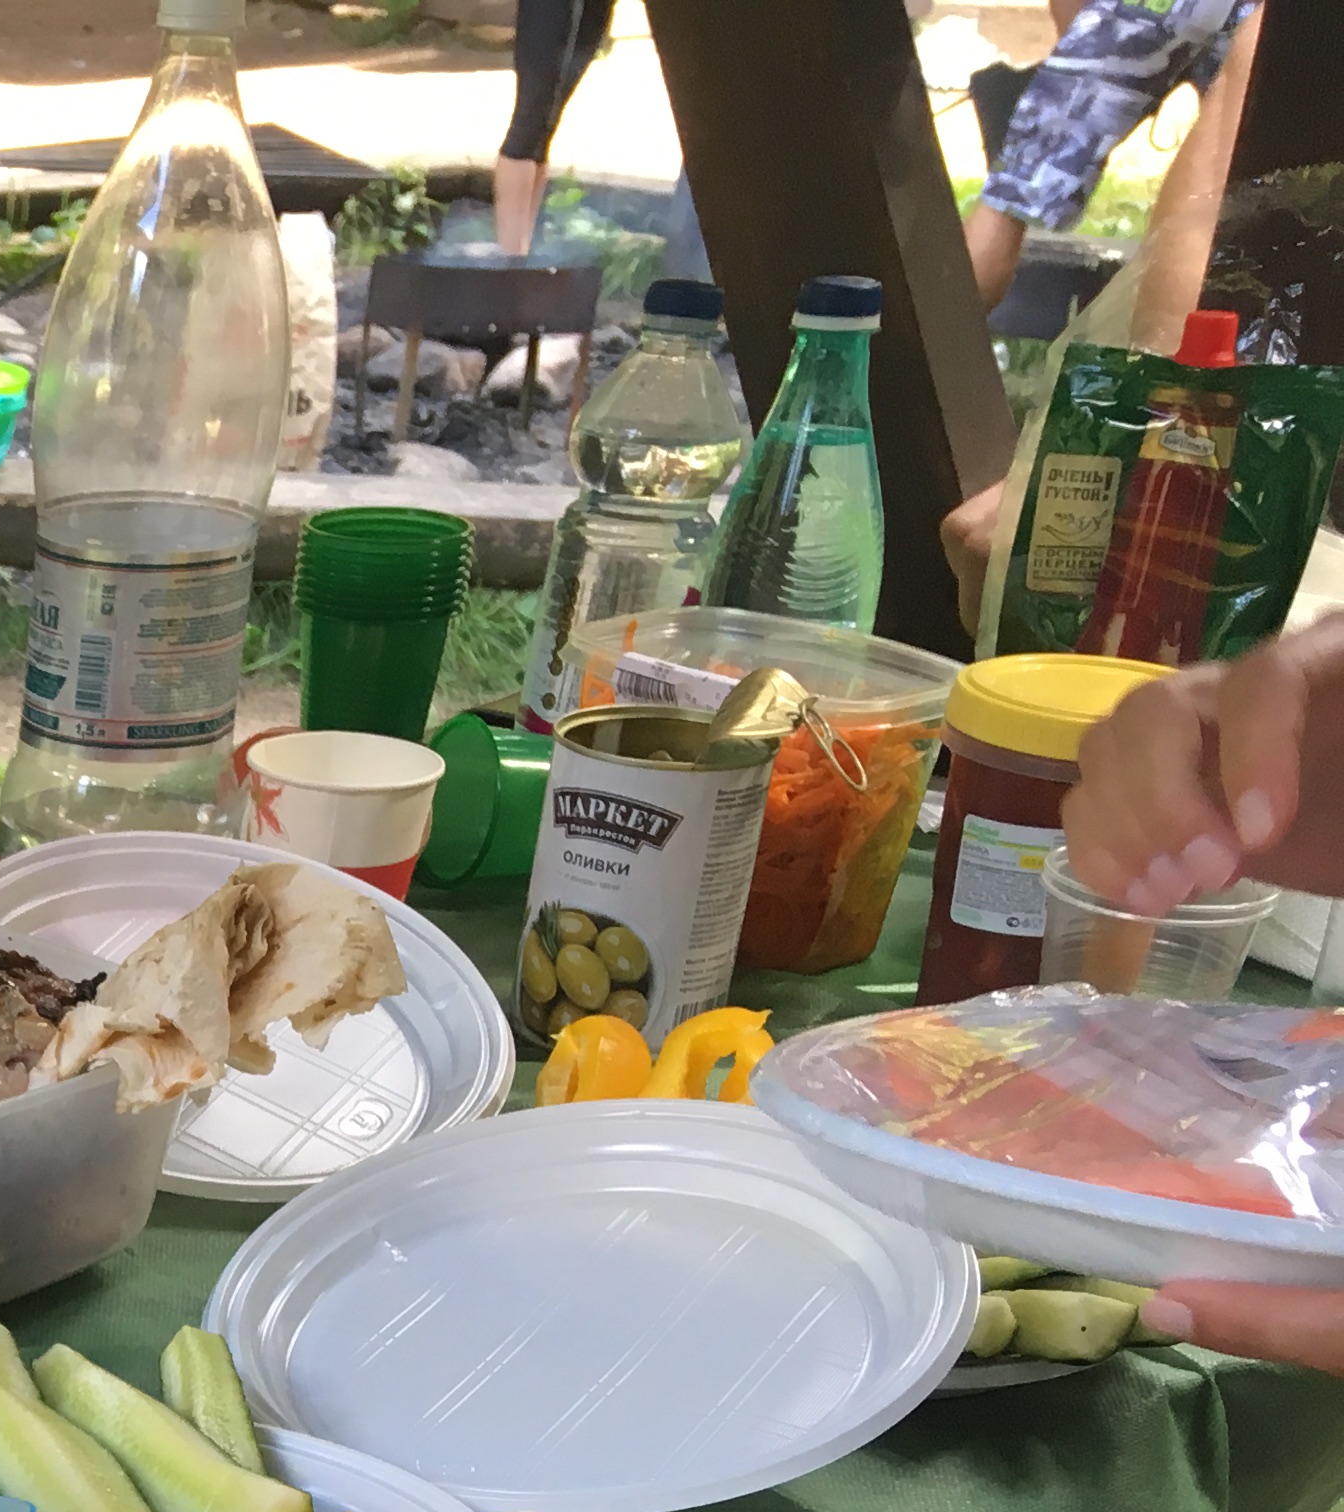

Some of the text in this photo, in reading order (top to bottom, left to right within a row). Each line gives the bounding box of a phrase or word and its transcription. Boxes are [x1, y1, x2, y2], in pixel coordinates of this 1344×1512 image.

[1047, 468, 1104, 484] ОЧЕНЬ
[557, 794, 669, 837] МАРКЕТ
[563, 850, 631, 876] ОЛИВКИ
